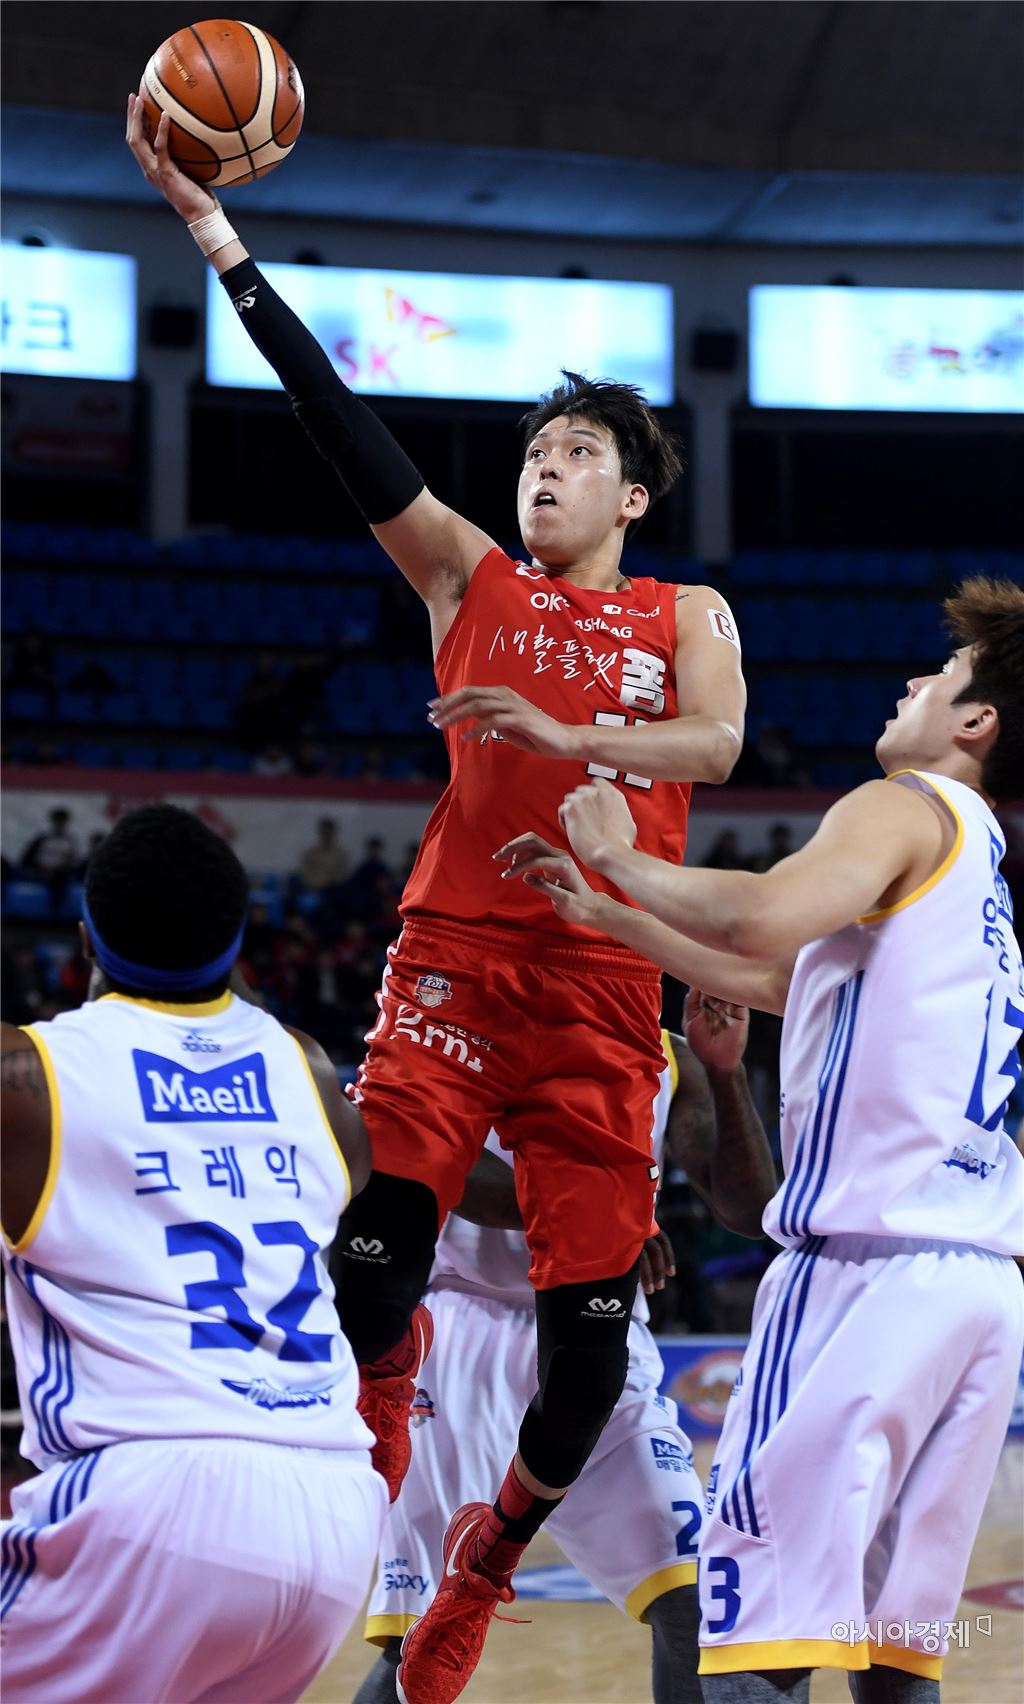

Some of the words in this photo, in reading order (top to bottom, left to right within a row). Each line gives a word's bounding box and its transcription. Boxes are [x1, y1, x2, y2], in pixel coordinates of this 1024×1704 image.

[333, 339, 398, 385] SK
[626, 606, 659, 618] Card
[146, 1069, 266, 1114] Maeil
[134, 1144, 301, 1199] 크레익
[165, 1220, 335, 1363] 32
[697, 1556, 742, 1634] 3
